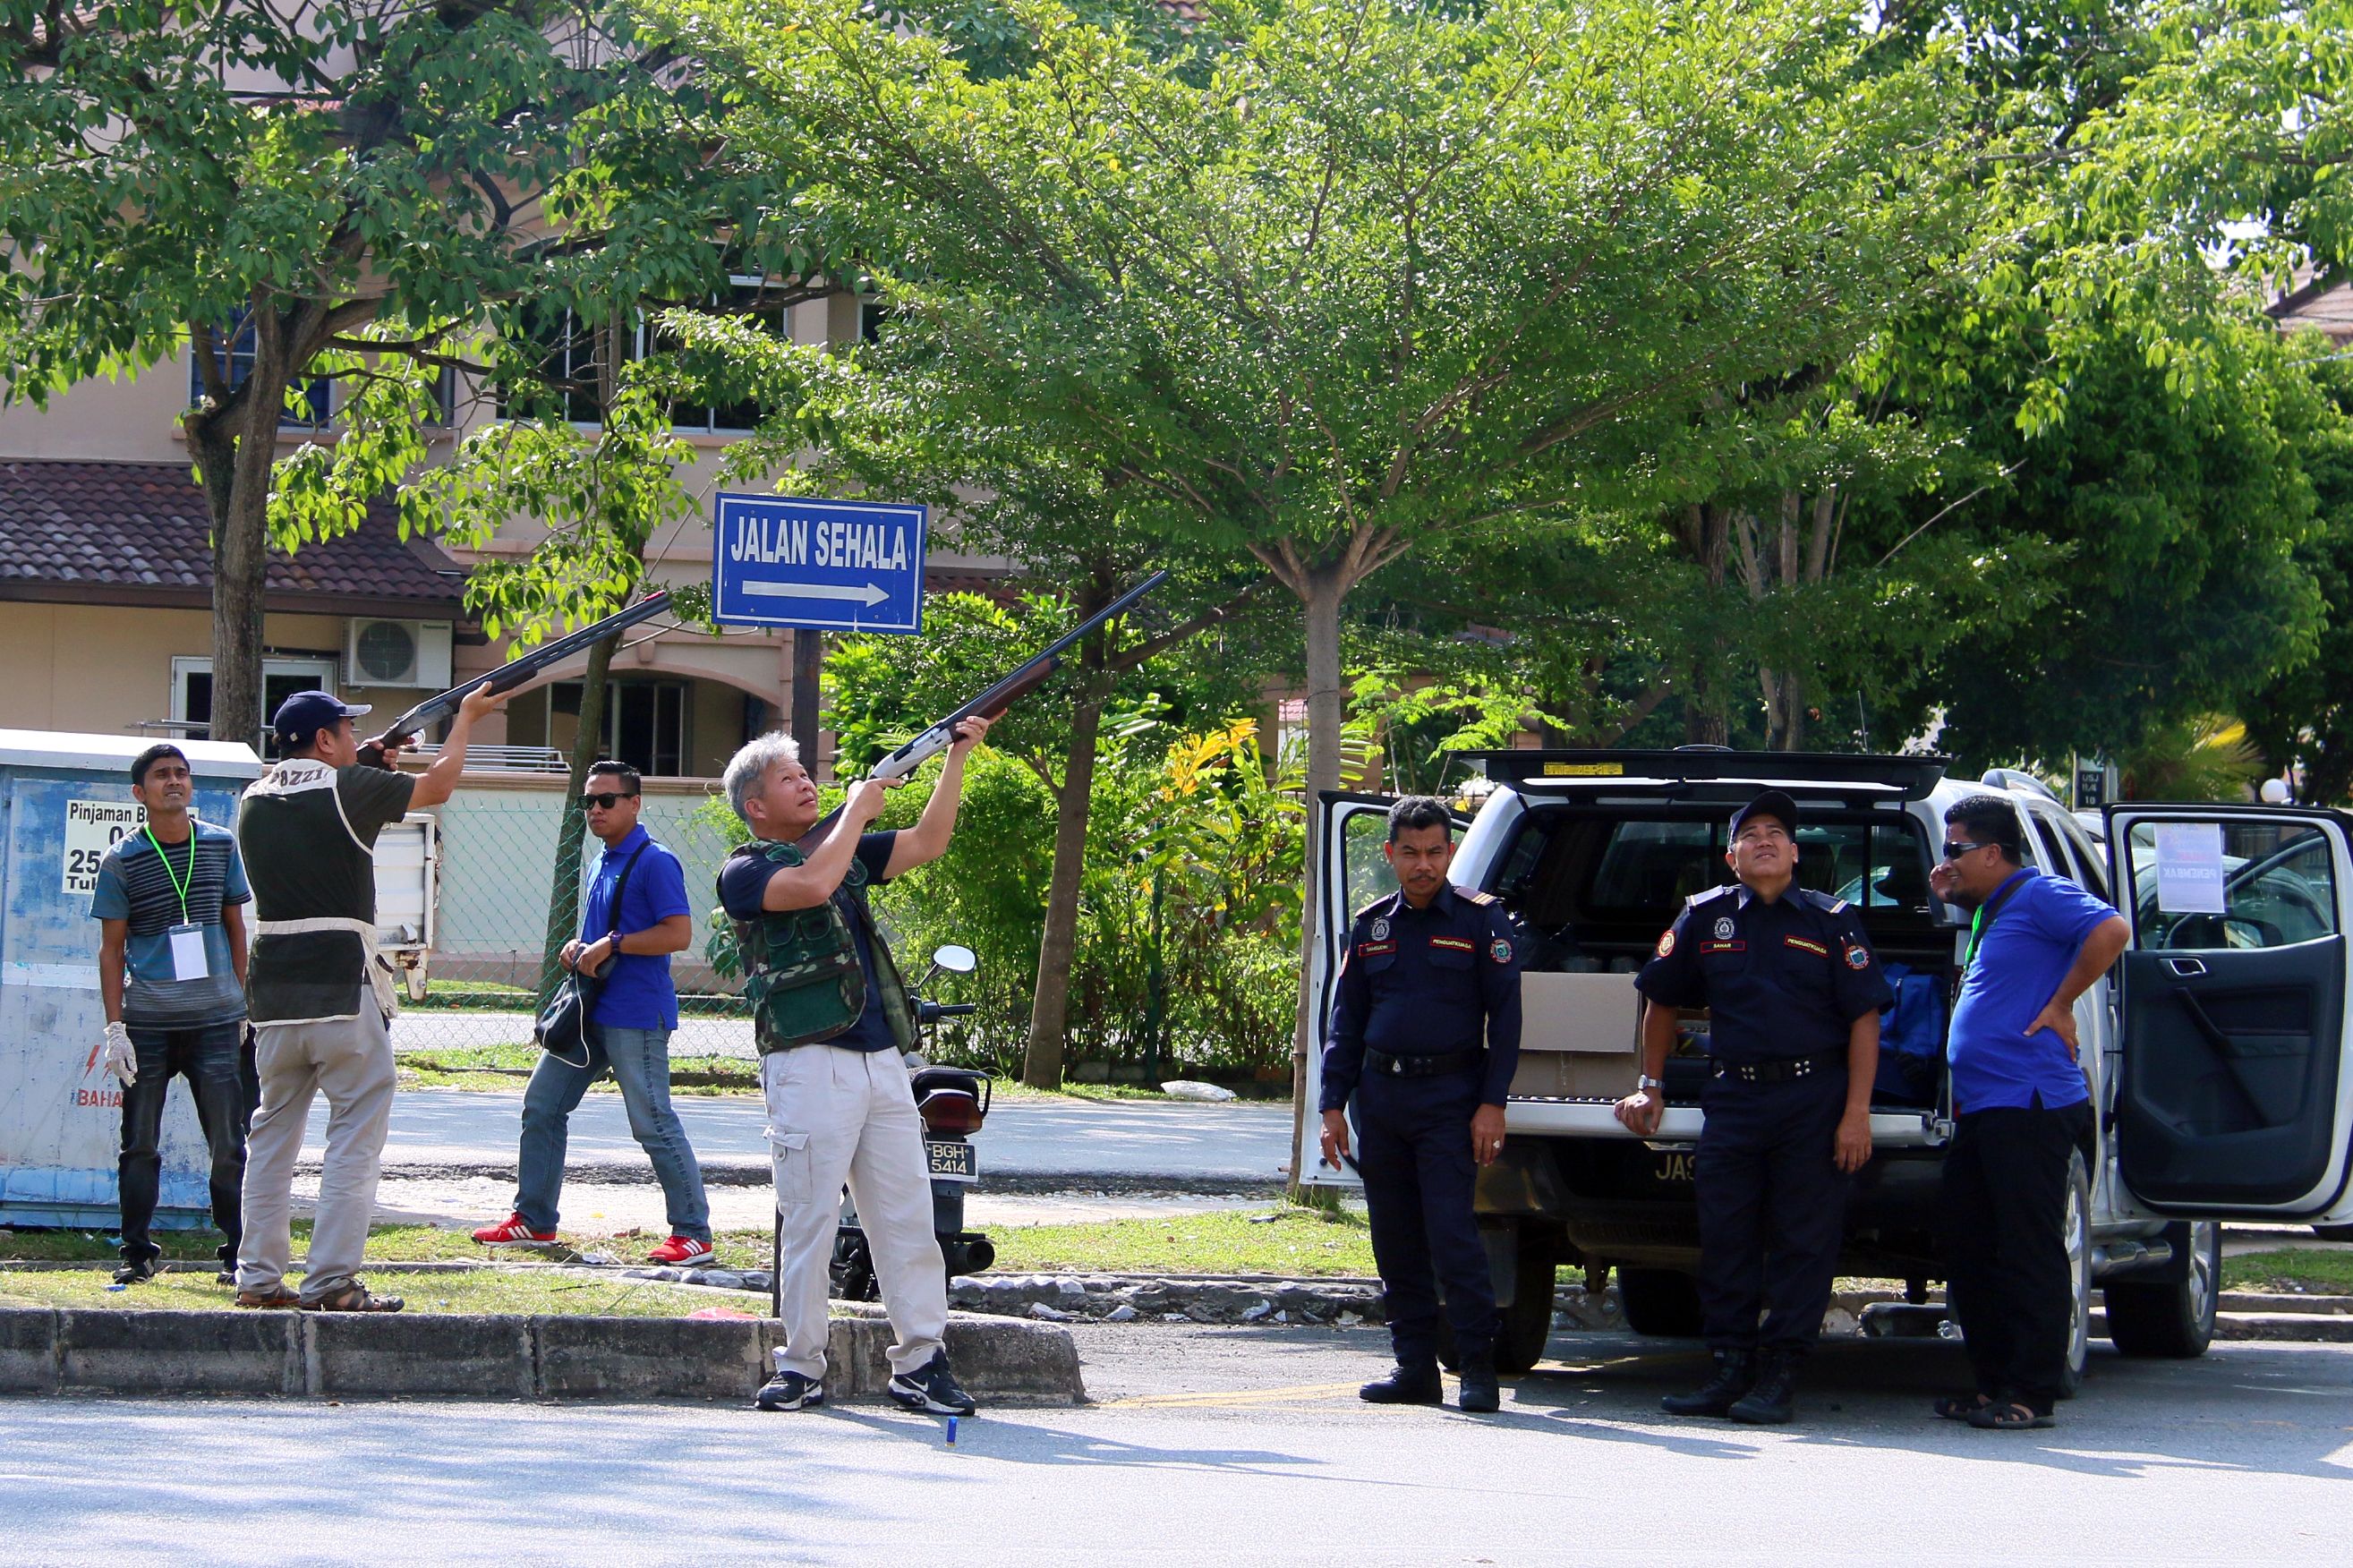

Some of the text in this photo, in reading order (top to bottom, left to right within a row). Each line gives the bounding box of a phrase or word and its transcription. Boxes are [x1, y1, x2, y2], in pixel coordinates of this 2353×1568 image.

[730, 516, 908, 571] JALAN SEHALA
[2082, 773, 2099, 782] USJ
[70, 803, 132, 824] Pinjaman
[933, 1145, 965, 1159] BGH
[931, 1159, 968, 1174] 5414
